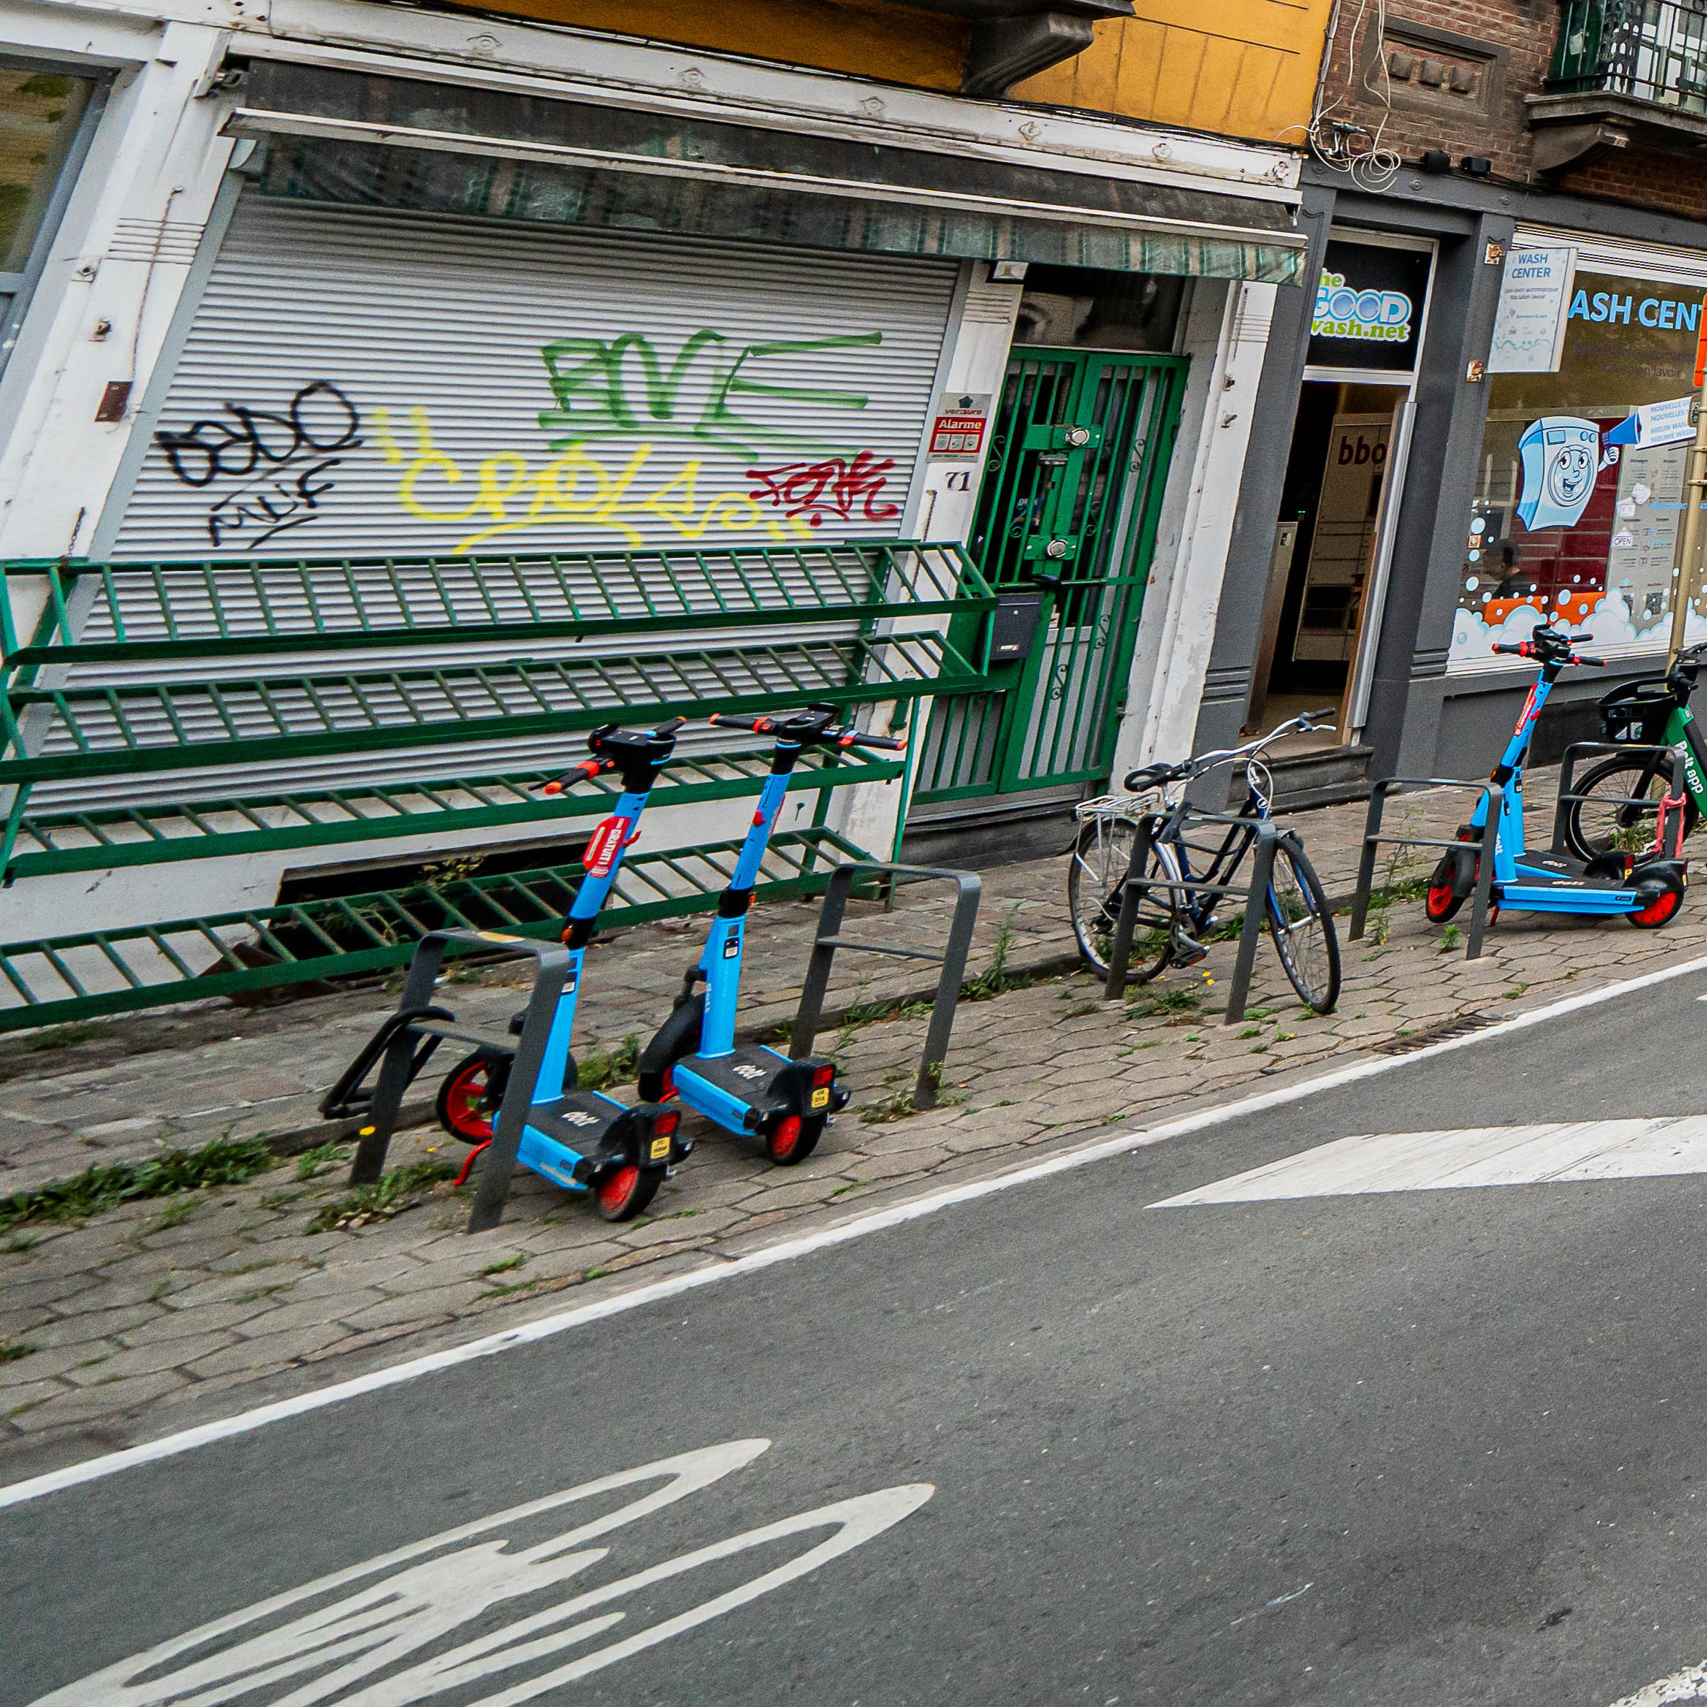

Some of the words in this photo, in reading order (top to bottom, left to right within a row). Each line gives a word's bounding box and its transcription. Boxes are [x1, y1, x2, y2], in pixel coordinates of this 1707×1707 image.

[1518, 254, 1549, 264] WASH
[1319, 269, 1344, 287] he
[1511, 267, 1552, 279] CENTER
[1567, 289, 1633, 325] ASH
[1637, 297, 1702, 332] CEN
[938, 419, 982, 430] Alarme
[945, 471, 971, 491] 71
[1613, 537, 1632, 546] OPEN
[1686, 769, 1704, 795] app
